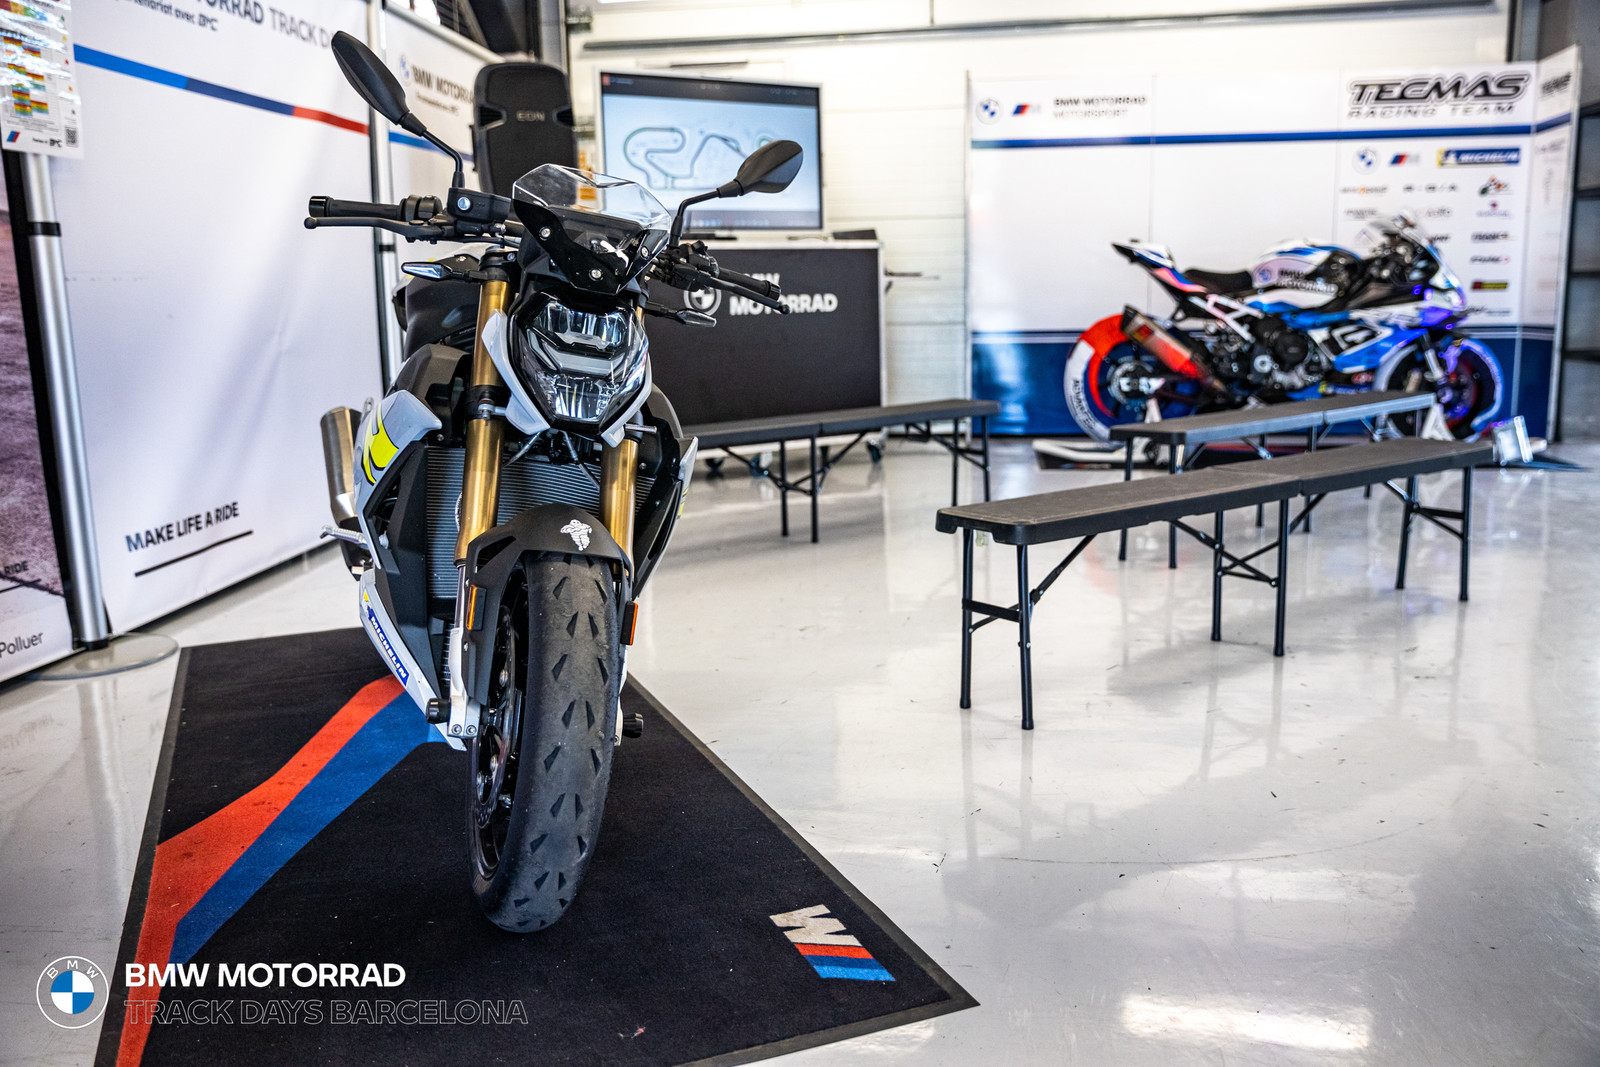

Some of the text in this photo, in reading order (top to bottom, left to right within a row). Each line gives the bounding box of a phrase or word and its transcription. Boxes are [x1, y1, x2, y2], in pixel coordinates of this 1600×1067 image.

[269, 7, 317, 46] TRACK
[412, 65, 433, 90] BMW
[1350, 73, 1530, 104] TECMAS
[1054, 97, 1080, 107] BMW
[1348, 102, 1514, 119] RACING TEAM
[125, 501, 240, 552] MAKE LIFE A RIDE
[4, 560, 29, 576] RIDE
[370, 616, 407, 679] MICHELIN
